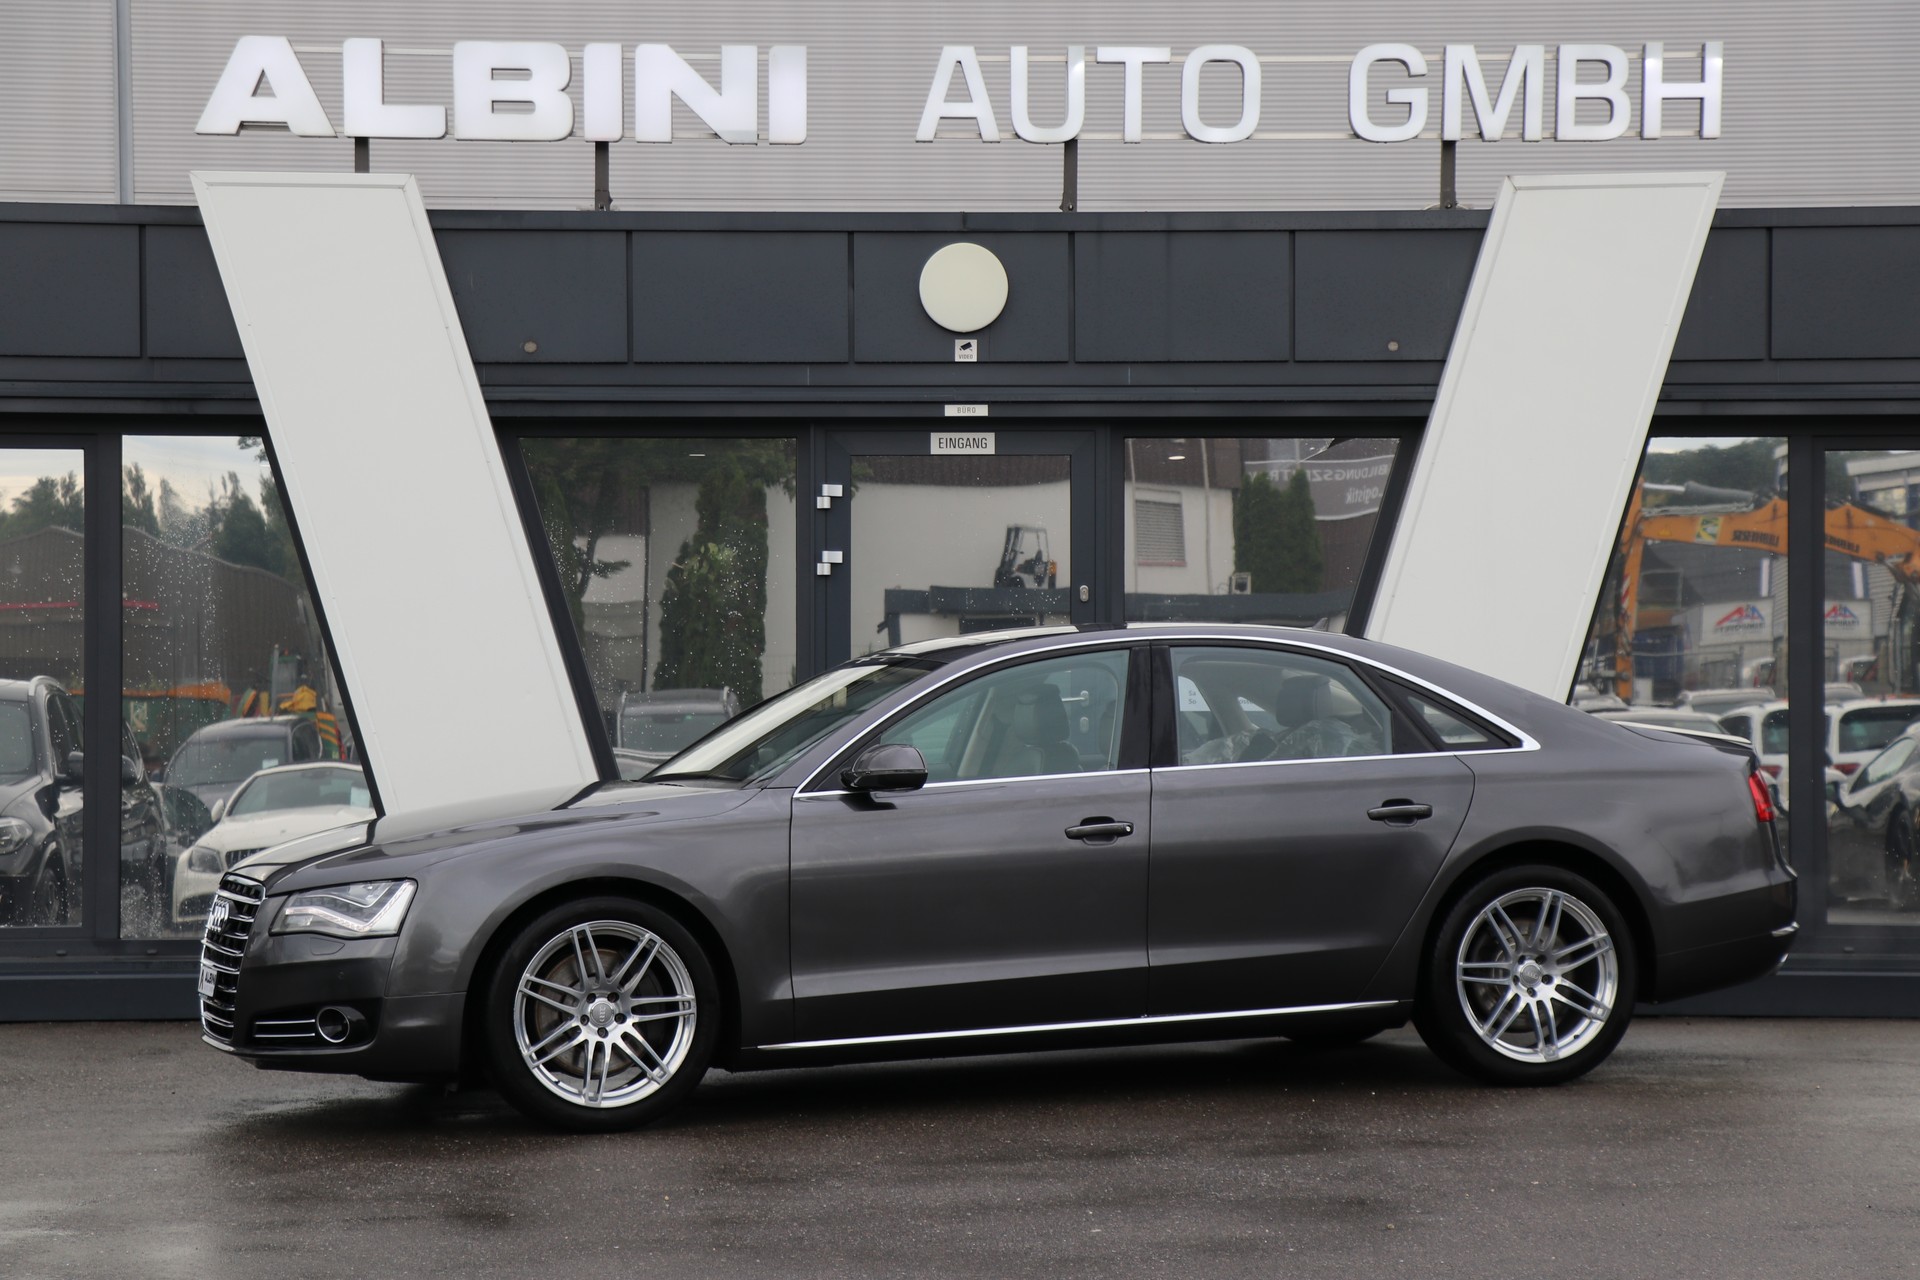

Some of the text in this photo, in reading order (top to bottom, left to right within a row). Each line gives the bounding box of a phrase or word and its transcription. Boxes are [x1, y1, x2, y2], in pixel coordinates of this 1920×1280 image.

[194, 34, 1724, 146] ALBINI AUTO GMBH
[957, 405, 976, 414] BÜRO
[938, 437, 988, 449] EINGANG
